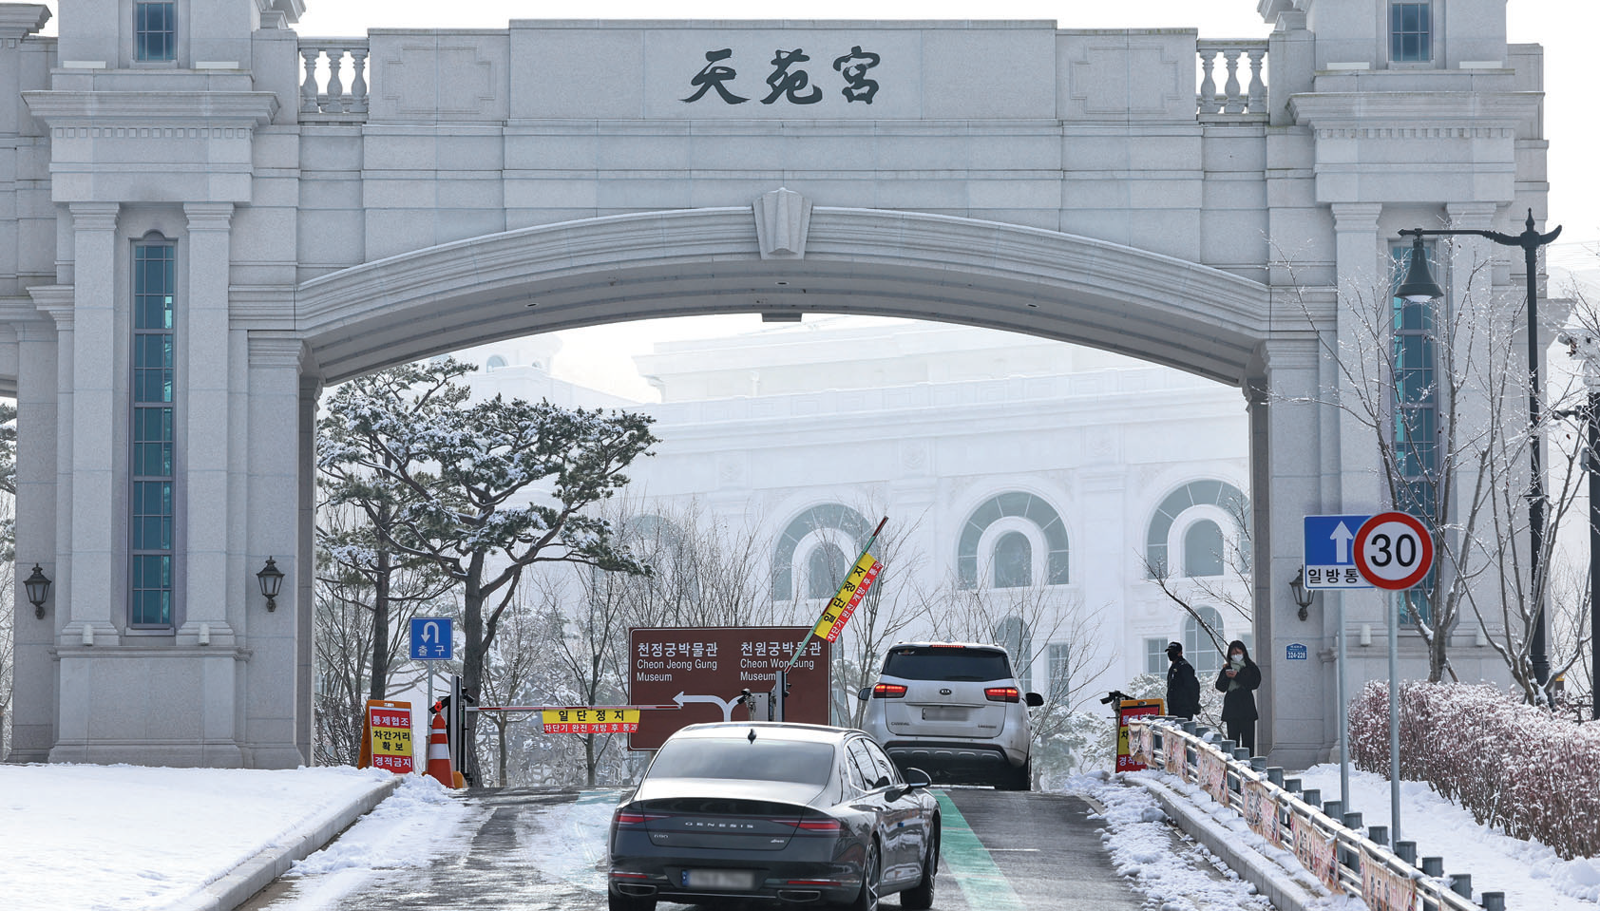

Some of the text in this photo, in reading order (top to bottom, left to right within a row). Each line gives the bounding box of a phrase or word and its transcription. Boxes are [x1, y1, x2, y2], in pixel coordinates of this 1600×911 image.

[678, 46, 880, 104] 天苑宮
[1371, 534, 1416, 567] 30
[1308, 568, 1359, 584] 일방통
[828, 619, 845, 641] 차단기
[637, 642, 718, 658] 천정궁박물관
[637, 659, 718, 672] Cheon Jeong Gung
[740, 658, 768, 668] Cheon
[770, 658, 790, 668] Won
[636, 672, 673, 682] Museum
[740, 671, 776, 681] Museum
[373, 715, 409, 726] 통제협조
[545, 723, 638, 732] 차단기 완전 개방 후 통과
[374, 730, 411, 742] 차간거리
[375, 756, 412, 768] 경적금지
